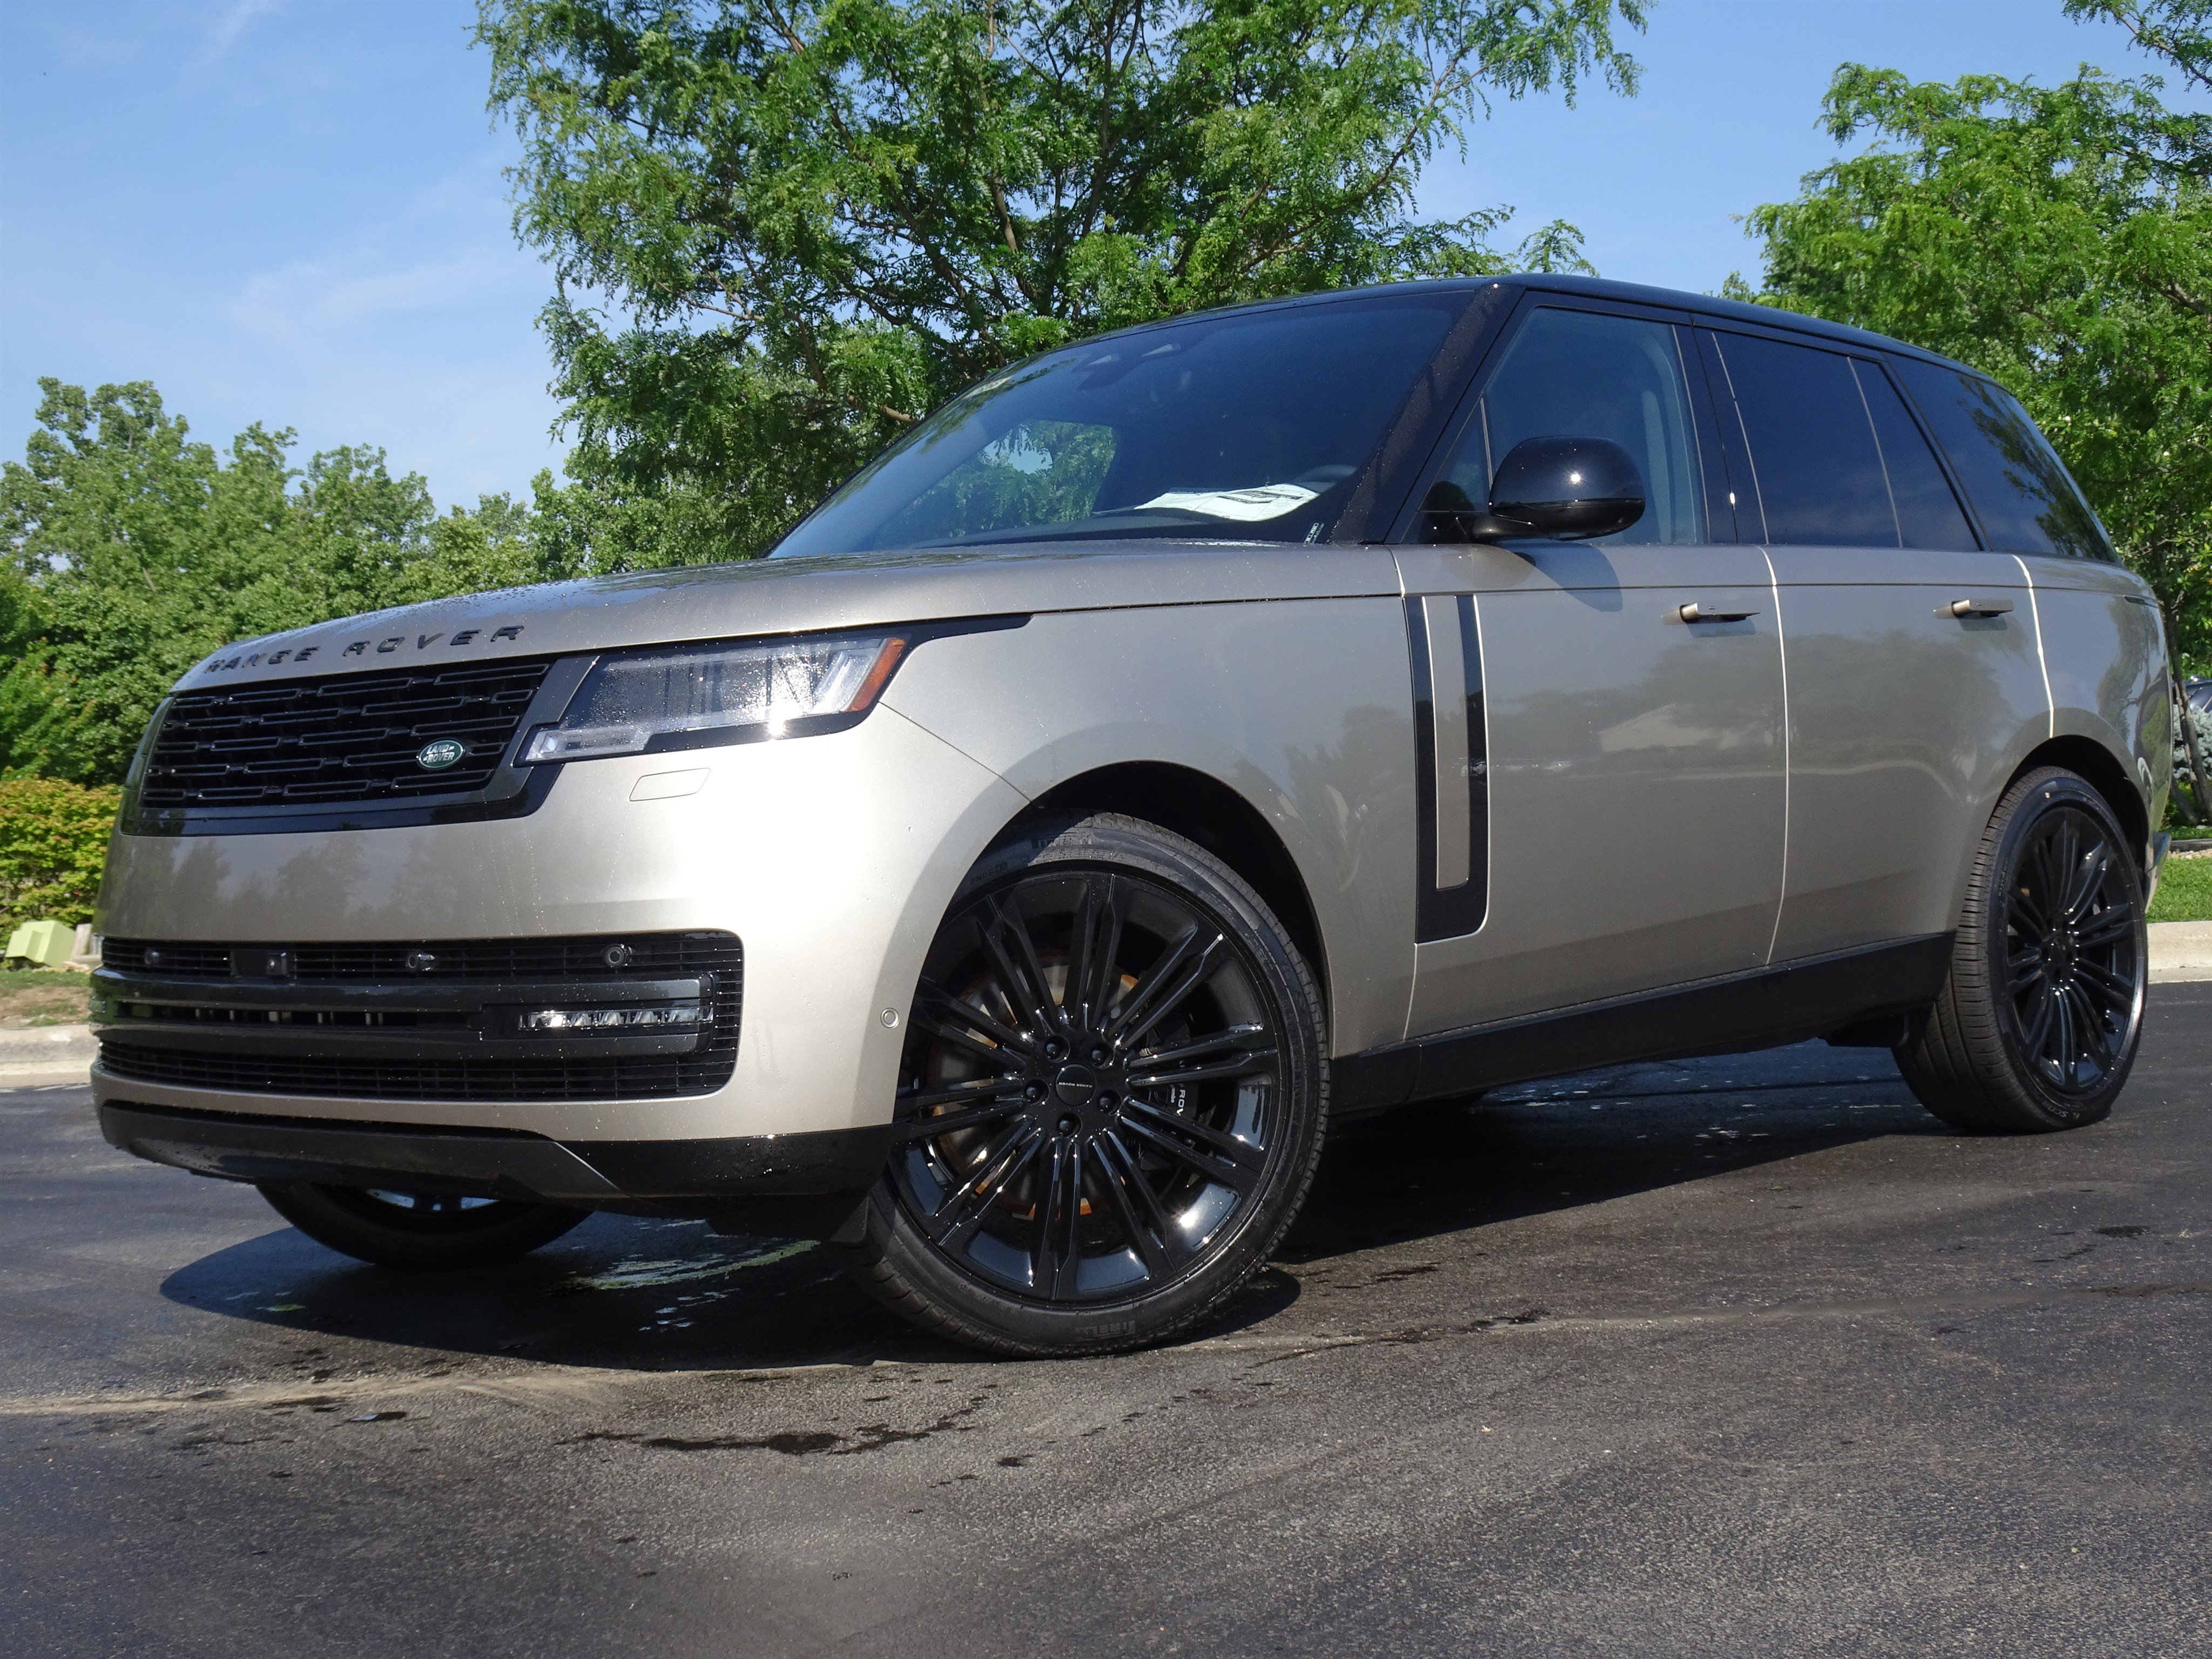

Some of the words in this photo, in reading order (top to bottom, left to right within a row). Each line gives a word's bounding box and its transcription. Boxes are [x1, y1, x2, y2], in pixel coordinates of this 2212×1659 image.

[204, 646, 321, 674] RANGE
[342, 625, 525, 657] ROVER
[427, 745, 450, 754] LAND
[427, 752, 455, 763] ROVER
